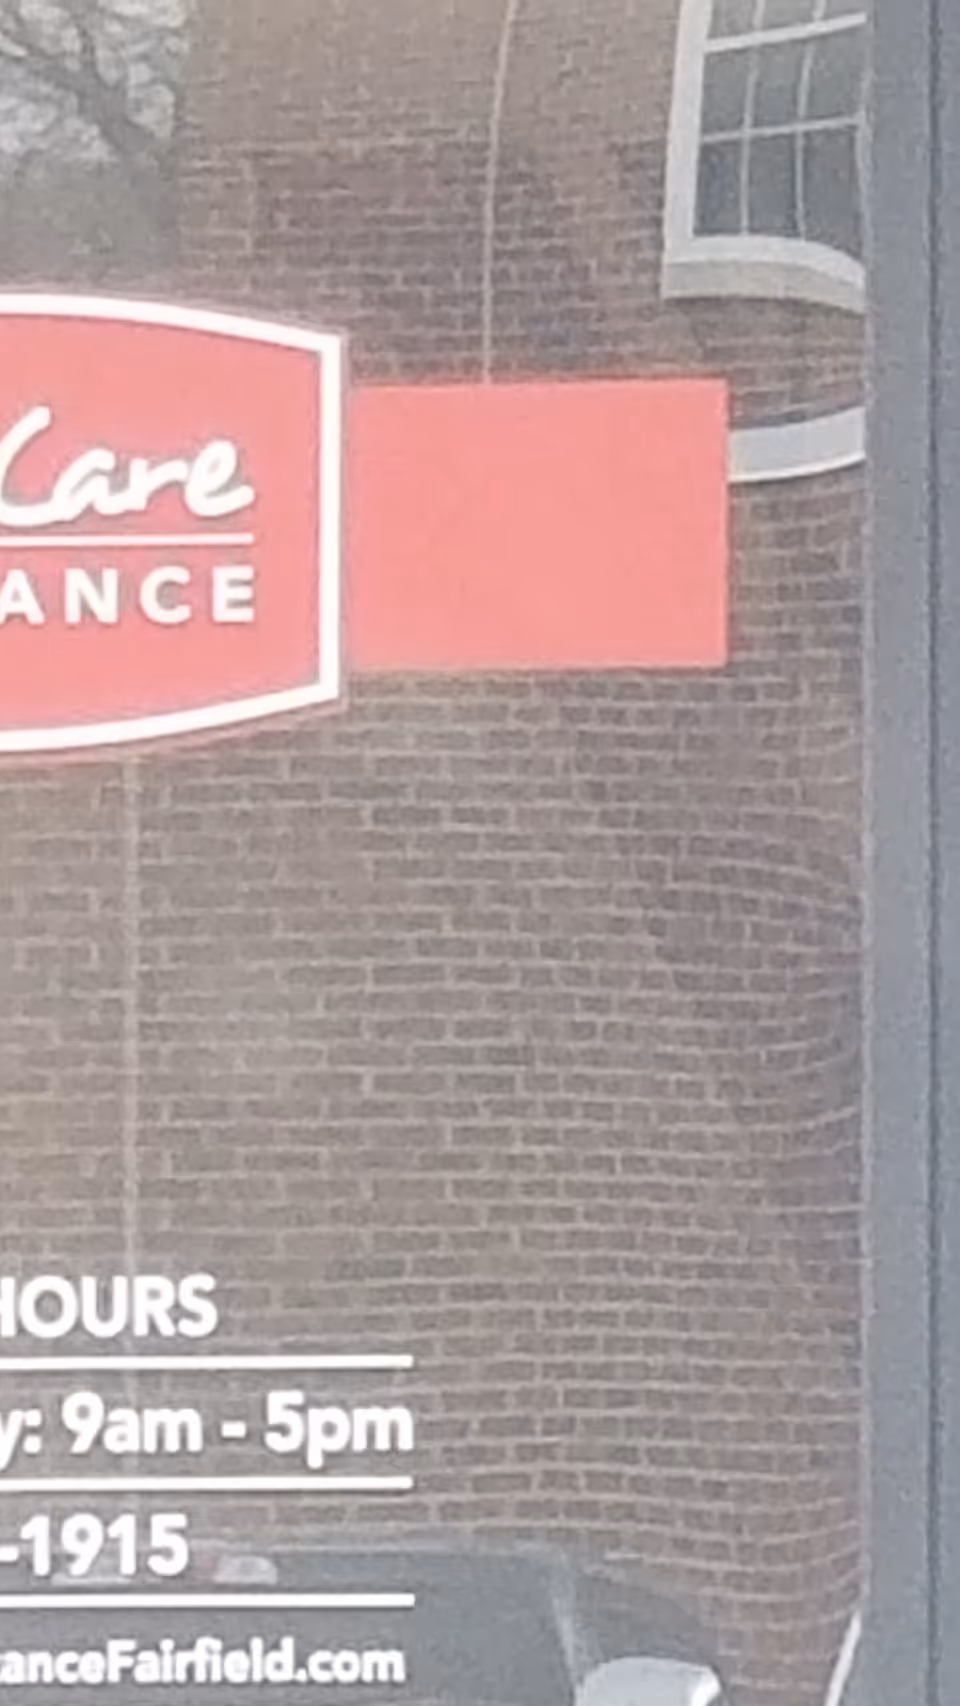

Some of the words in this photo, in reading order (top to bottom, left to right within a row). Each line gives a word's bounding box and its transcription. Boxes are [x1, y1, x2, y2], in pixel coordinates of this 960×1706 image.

[63, 1392, 202, 1454] 9am
[222, 1422, 246, 1438] -
[265, 1391, 414, 1467] 5pm
